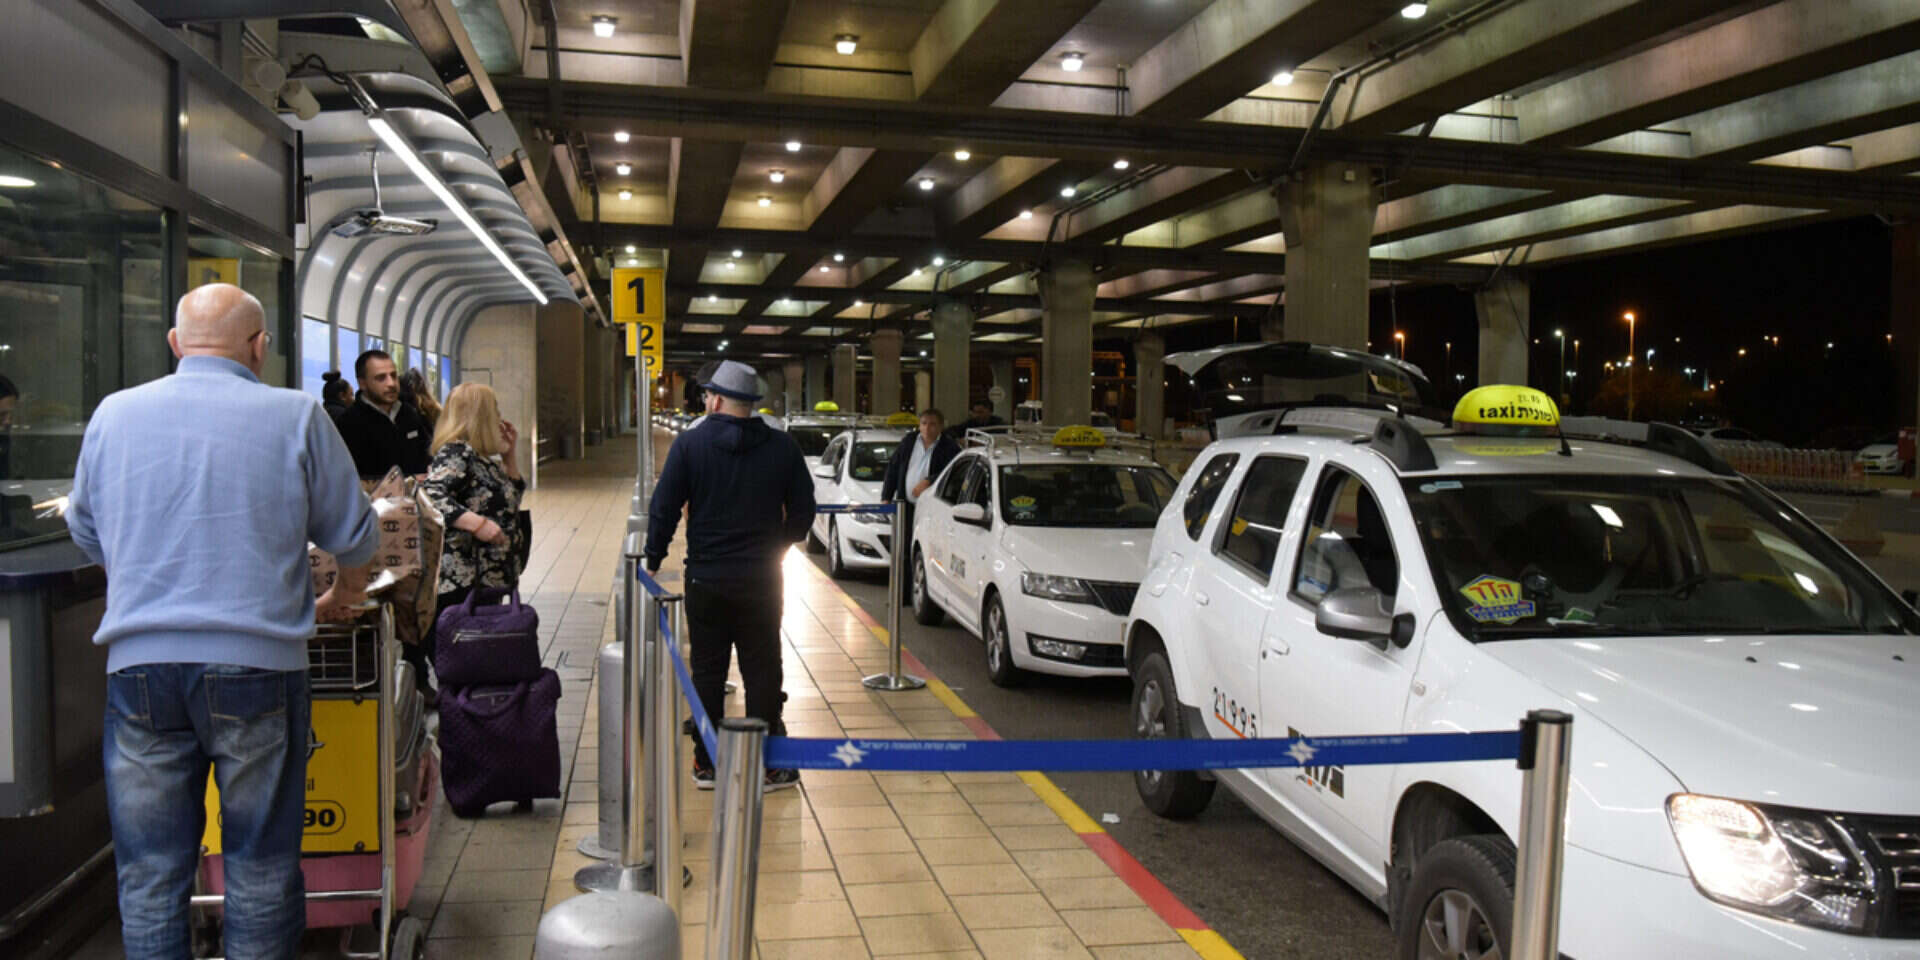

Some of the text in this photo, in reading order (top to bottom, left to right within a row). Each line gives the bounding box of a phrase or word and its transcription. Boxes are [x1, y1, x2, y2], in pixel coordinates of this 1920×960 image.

[627, 277, 645, 314] 1
[640, 325, 654, 350] 2
[1478, 402, 1553, 422] taxi מונית
[1214, 686, 1257, 739] 21995
